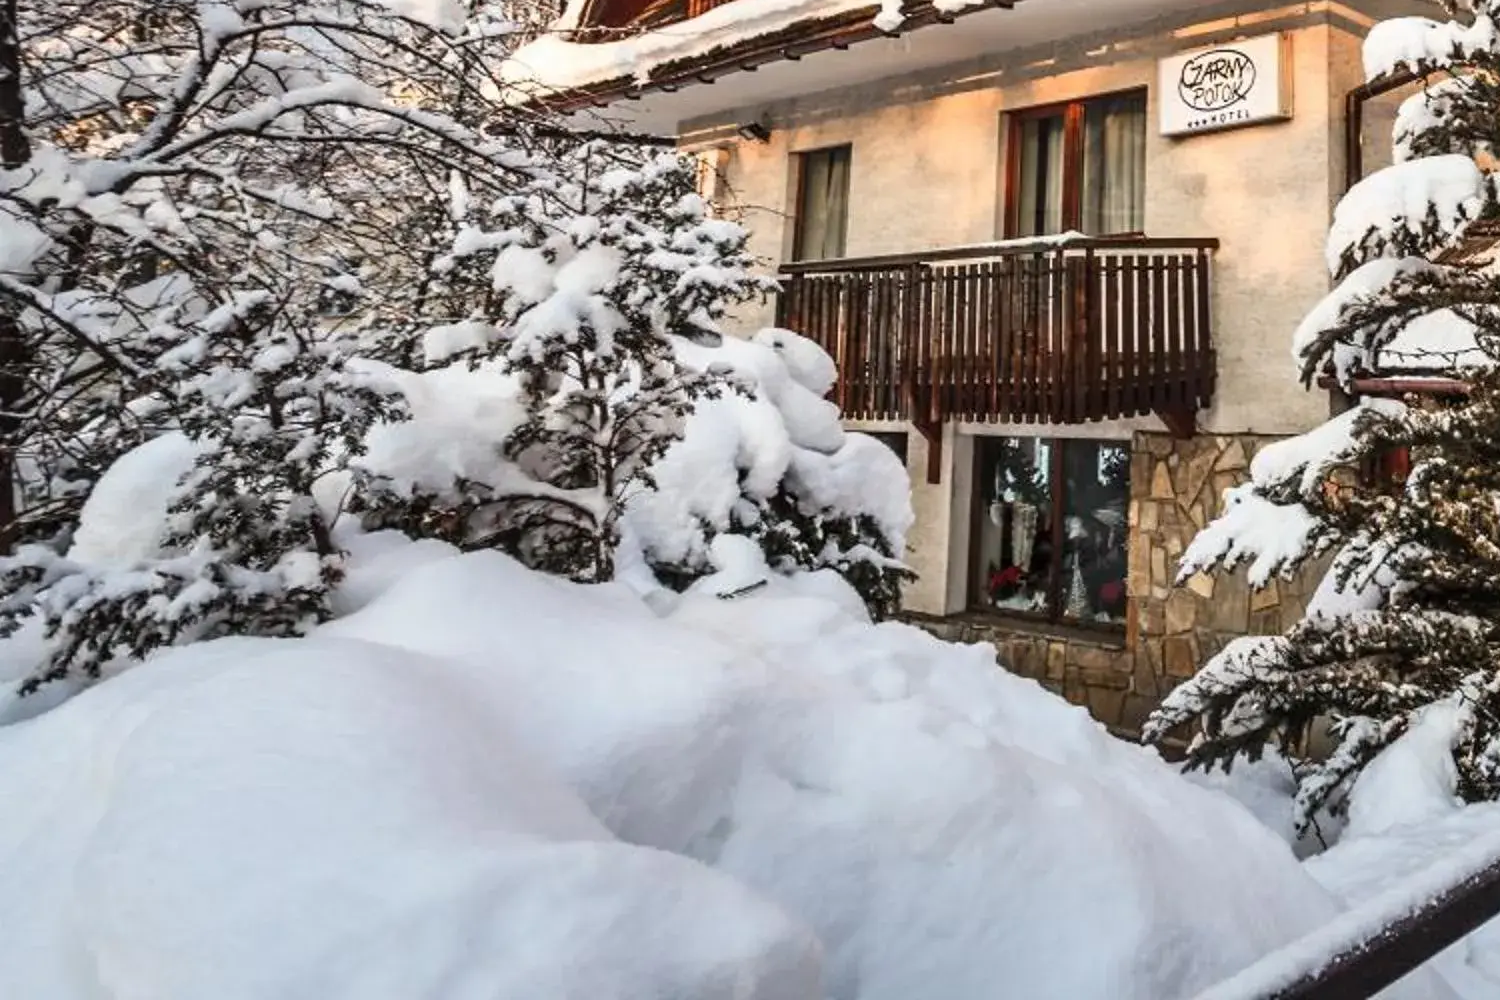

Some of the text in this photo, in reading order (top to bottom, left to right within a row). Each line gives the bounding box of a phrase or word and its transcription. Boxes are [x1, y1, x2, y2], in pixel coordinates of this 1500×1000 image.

[1182, 57, 1249, 88] CZARNY
[1192, 81, 1246, 107] POTOK
[1211, 109, 1249, 123] HOTEL
